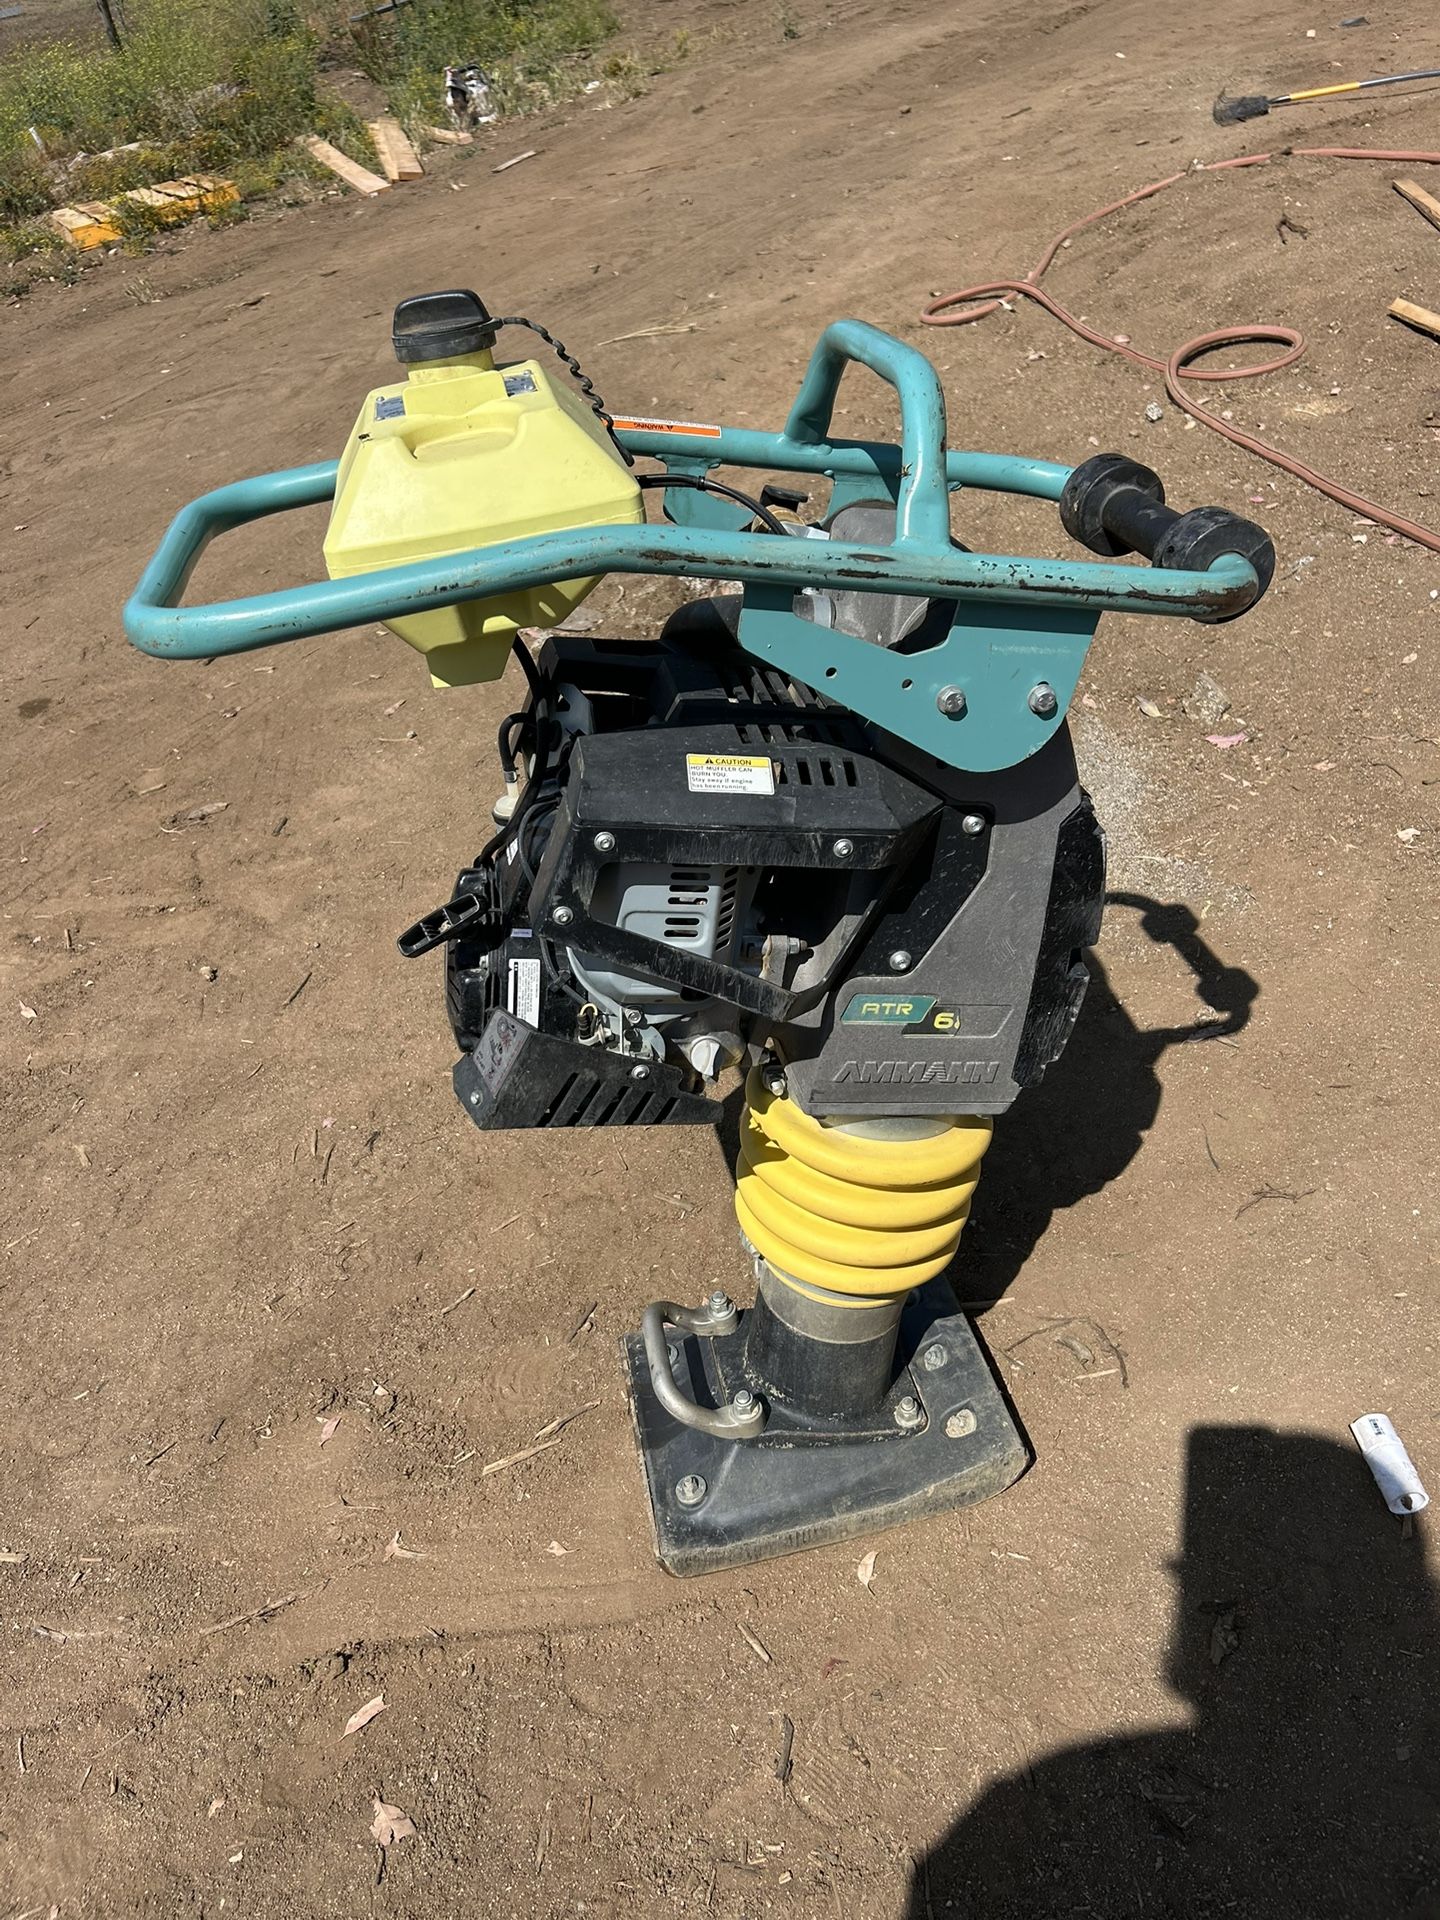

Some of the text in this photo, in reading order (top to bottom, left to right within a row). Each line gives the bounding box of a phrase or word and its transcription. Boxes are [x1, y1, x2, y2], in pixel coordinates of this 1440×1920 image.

[633, 422, 664, 431] WARNING
[715, 758, 752, 766] CAUTION
[861, 1002, 914, 1016] ATR
[832, 1060, 1001, 1084] AMMANN
